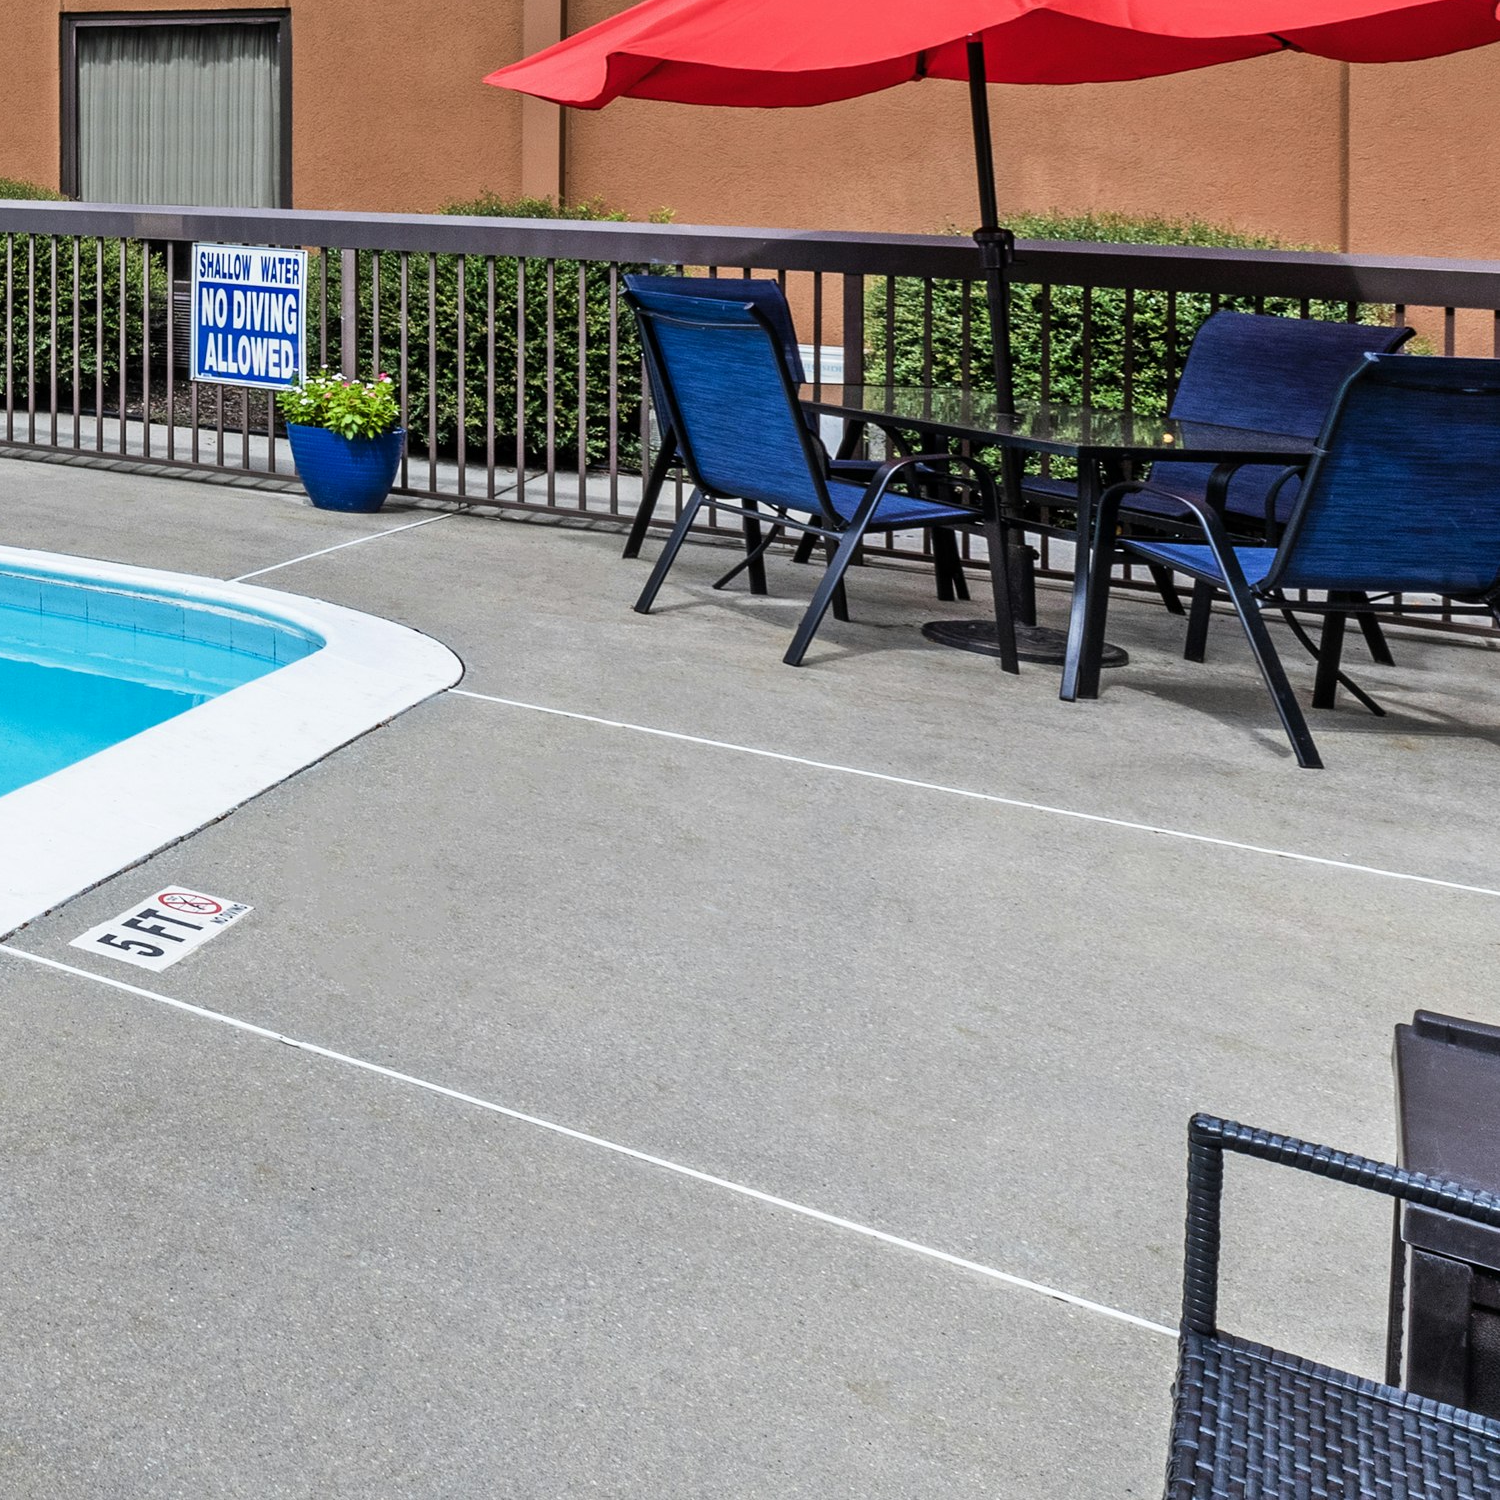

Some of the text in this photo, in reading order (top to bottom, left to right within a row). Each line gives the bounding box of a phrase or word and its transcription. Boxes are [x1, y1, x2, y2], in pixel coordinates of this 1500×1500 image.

[200, 251, 300, 285] SHALLOW WATER
[201, 287, 297, 335] NO DIVING
[204, 332, 294, 380] ALLOWED
[96, 907, 204, 957] 5 FT
